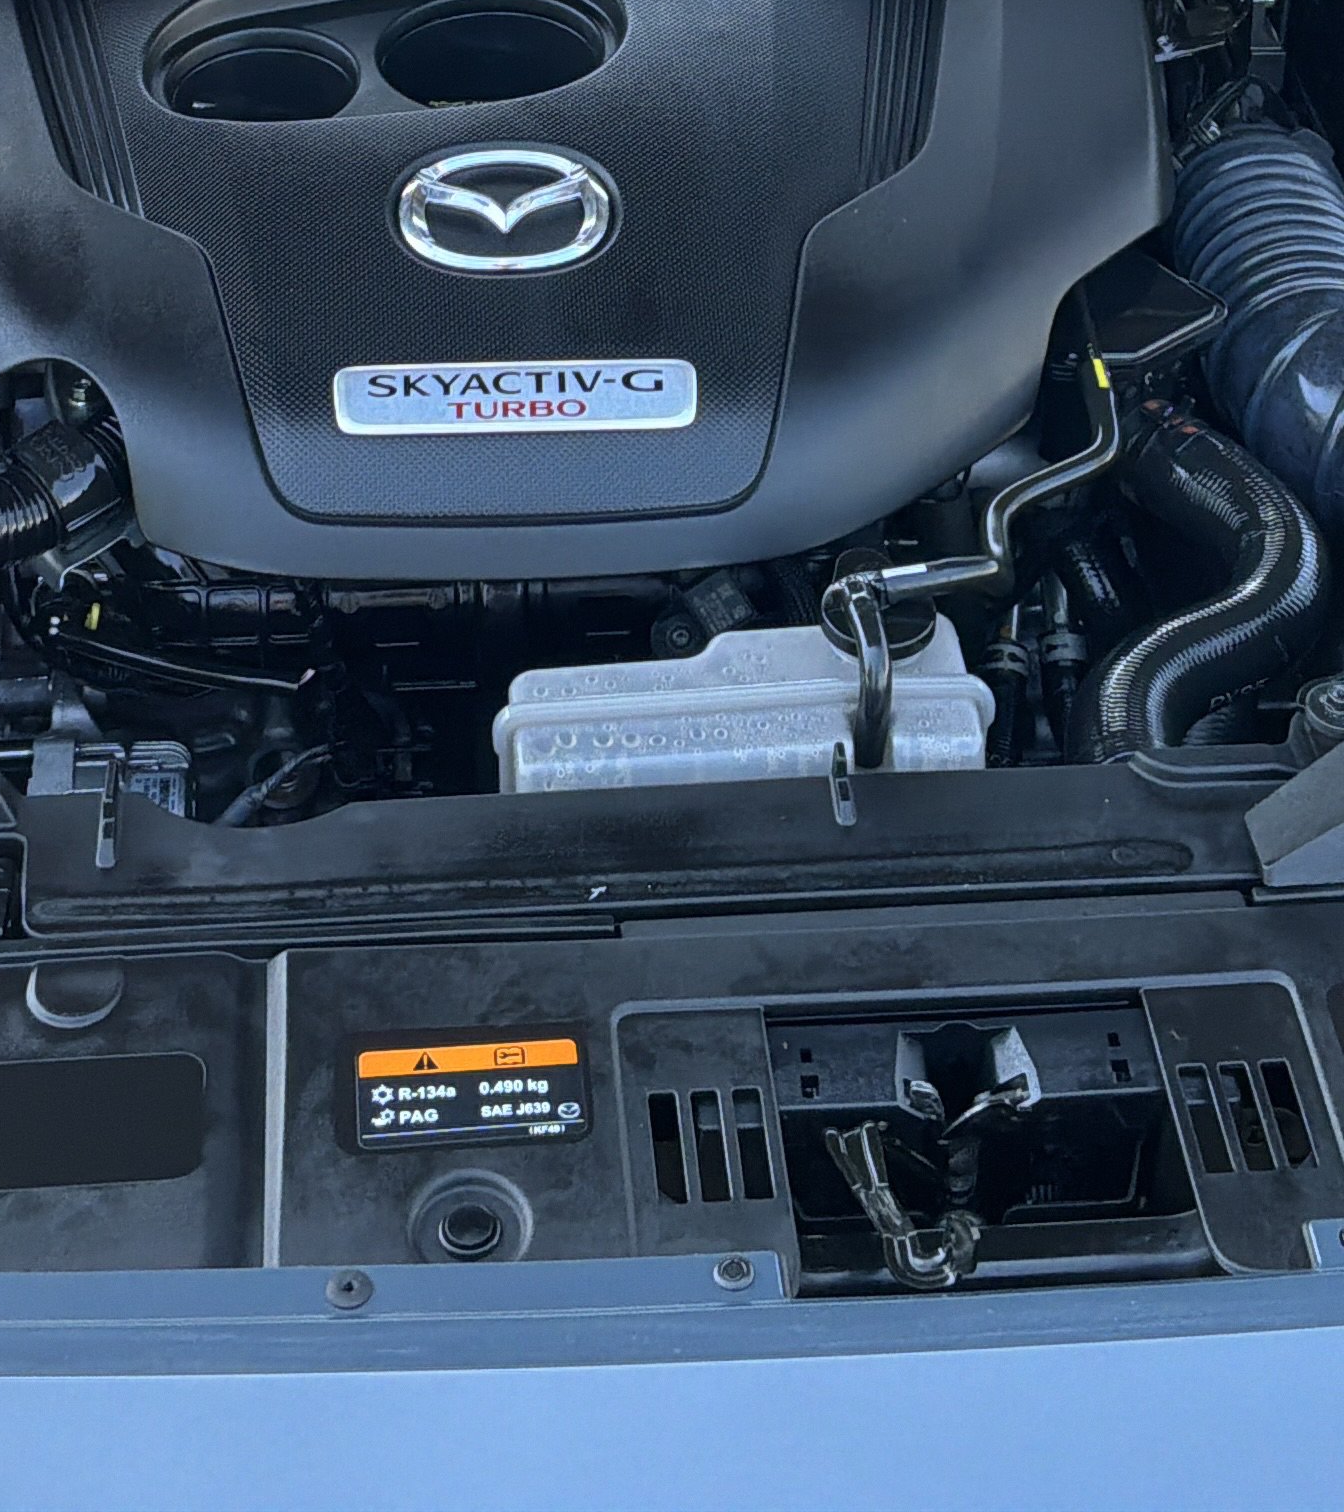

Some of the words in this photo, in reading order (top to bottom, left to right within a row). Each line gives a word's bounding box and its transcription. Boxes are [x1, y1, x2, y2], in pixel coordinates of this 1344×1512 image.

[367, 369, 664, 398] SKYACTIV-G
[447, 399, 587, 419] TURBO
[398, 1085, 456, 1101] R-134a
[478, 1080, 524, 1096] 0.490
[527, 1078, 549, 1094] kg
[399, 1108, 439, 1125] PAG
[480, 1104, 514, 1119] SAE
[516, 1102, 551, 1115] J639
